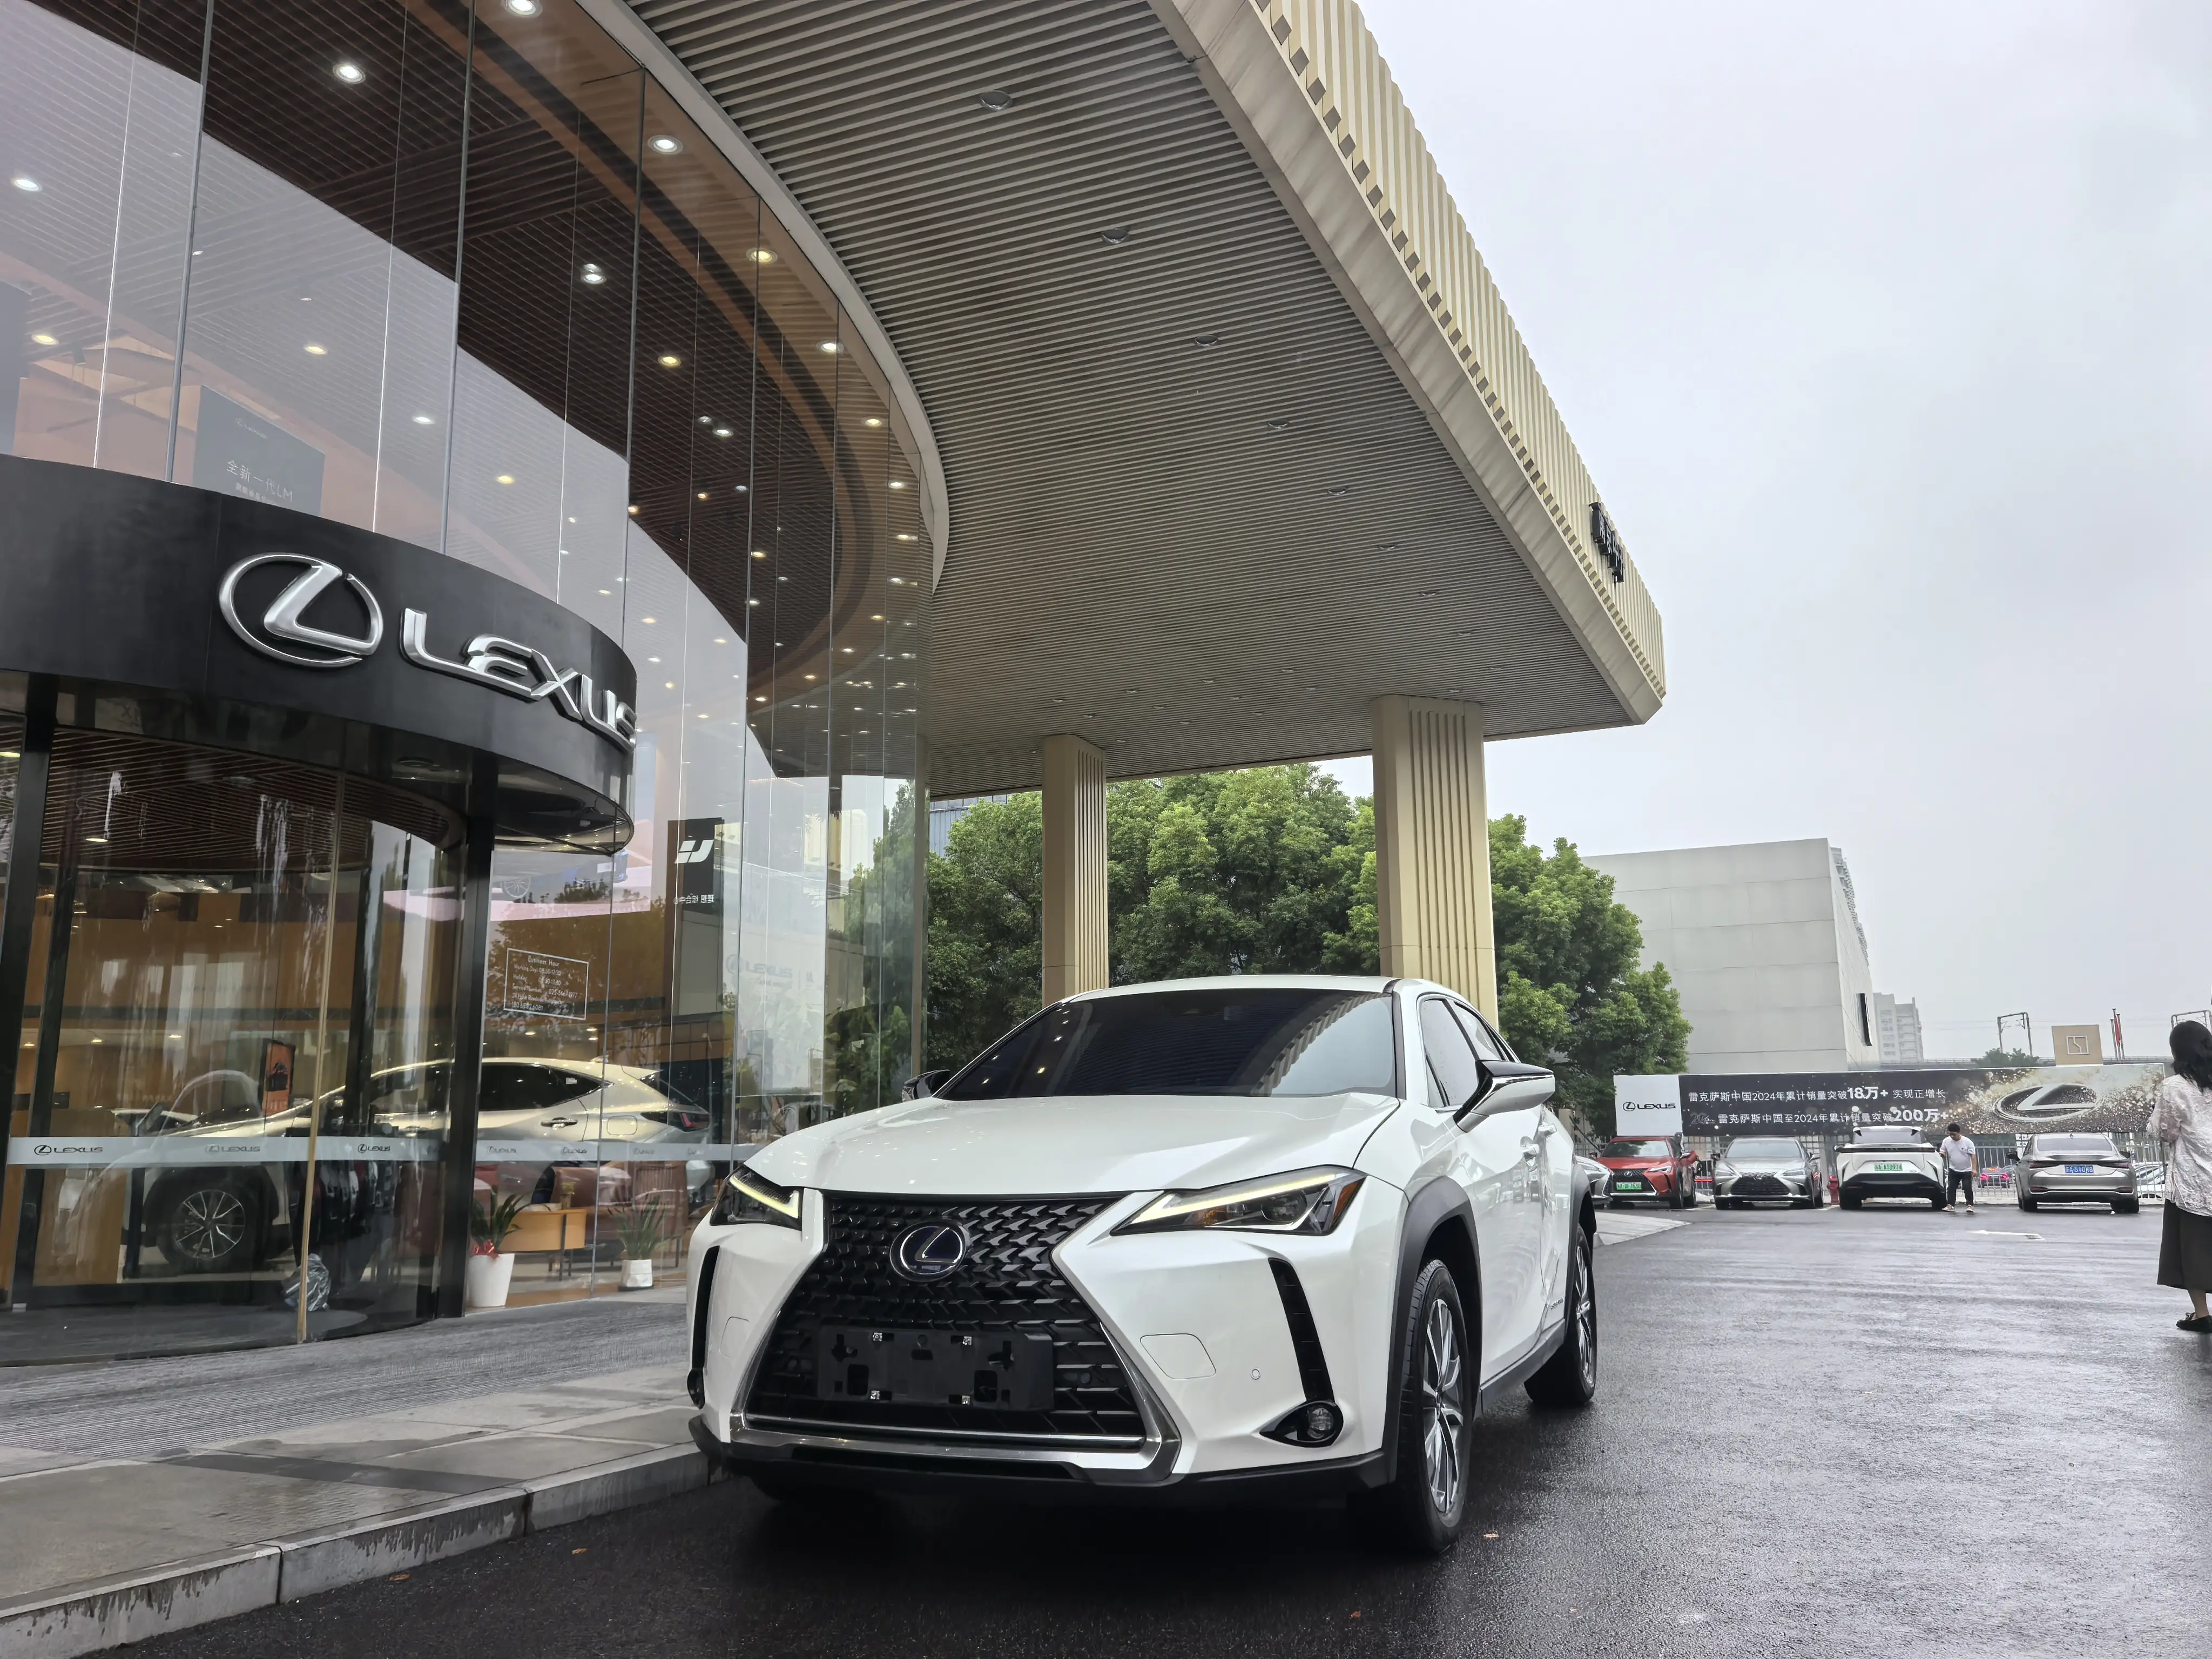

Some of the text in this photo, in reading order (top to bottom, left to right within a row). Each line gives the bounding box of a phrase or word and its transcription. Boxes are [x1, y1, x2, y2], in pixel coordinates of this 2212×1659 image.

[401, 608, 637, 753] LEXUS
[1892, 1089, 1946, 1099] 实现正增长
